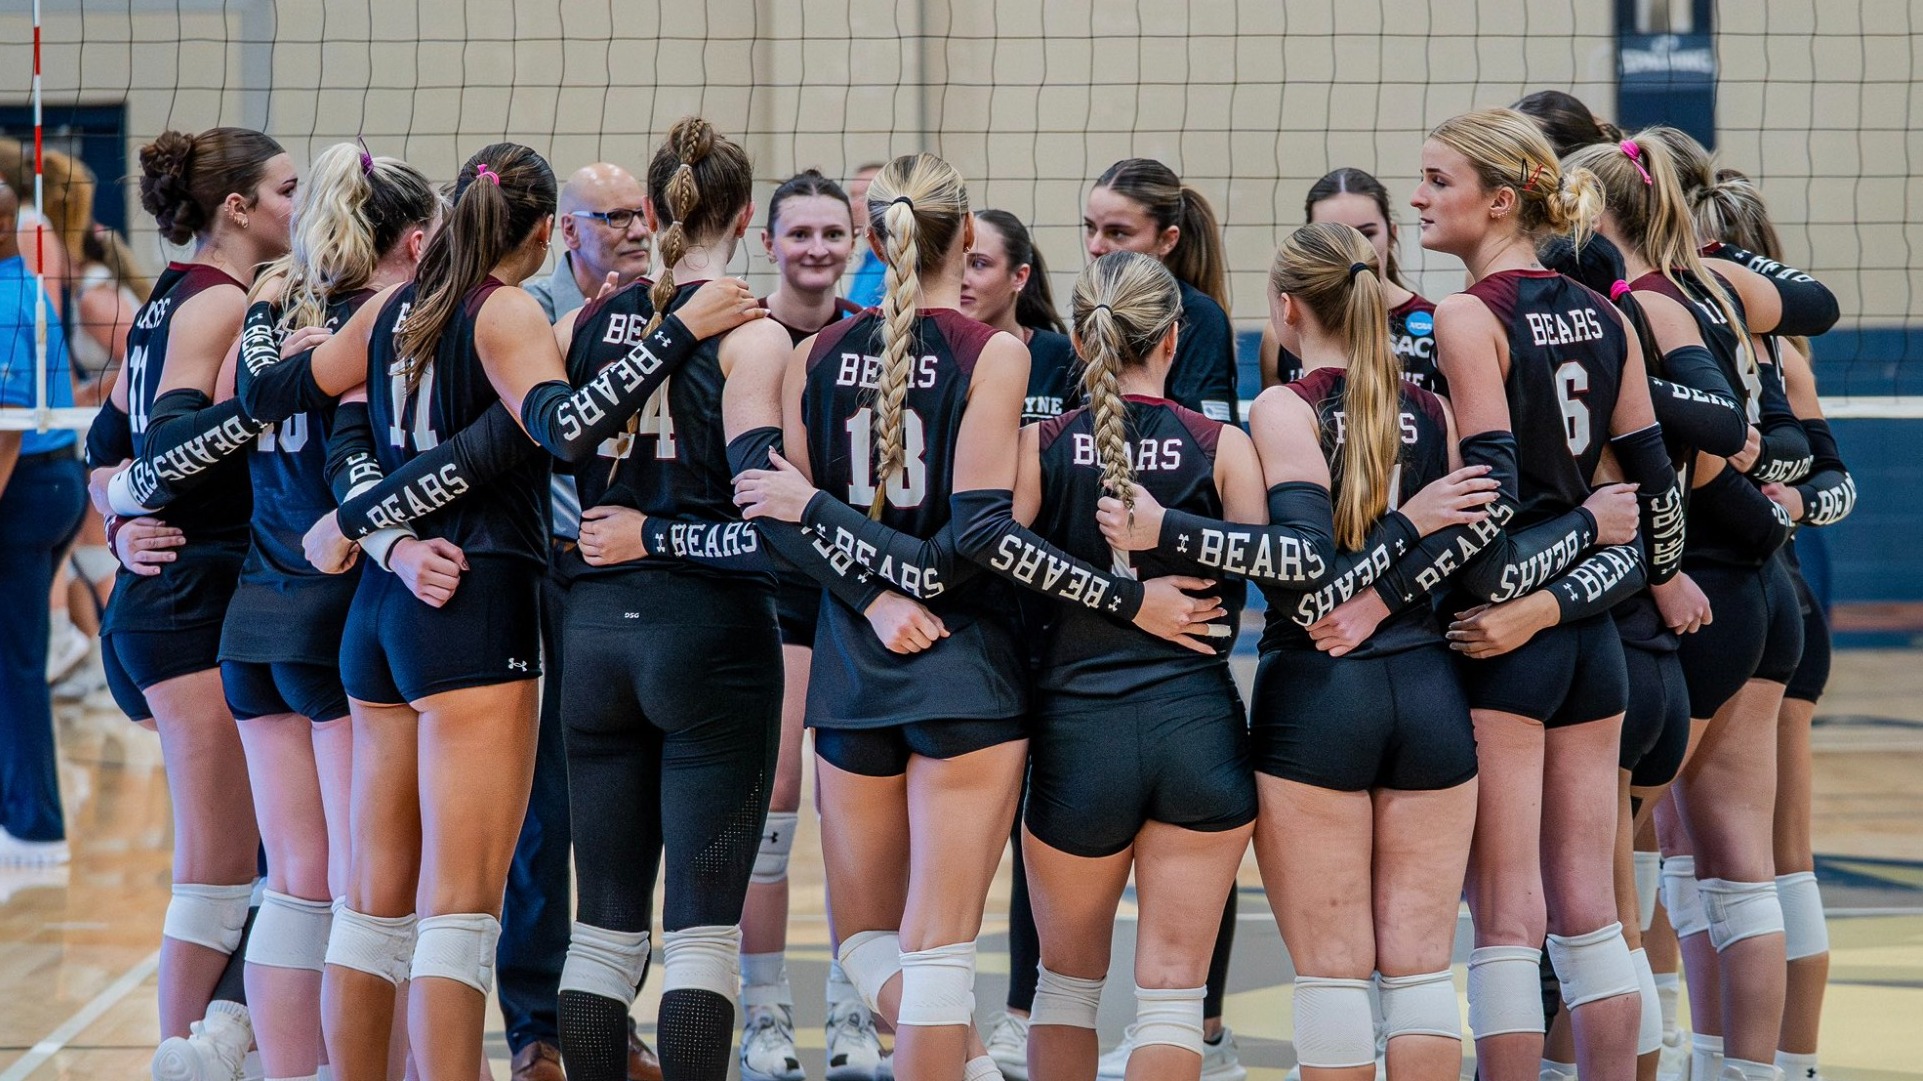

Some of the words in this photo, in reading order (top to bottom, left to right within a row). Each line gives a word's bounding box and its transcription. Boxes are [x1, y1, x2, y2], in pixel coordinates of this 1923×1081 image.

[242, 324, 280, 377] BEAR
[1525, 308, 1603, 346] BEARS
[557, 342, 663, 441] BEARS
[1555, 361, 1590, 456] 6
[152, 415, 256, 481] BEARS
[366, 463, 470, 530] BEARS
[1650, 485, 1685, 566] BEARS
[670, 521, 758, 558] BEARS
[835, 526, 945, 599] BEARS
[990, 534, 1110, 609] BEARS
[1198, 528, 1326, 582] BEARS
[1415, 502, 1515, 591] BEARS
[1490, 530, 1579, 602] BEARS
[1291, 543, 1391, 627] BEARS
